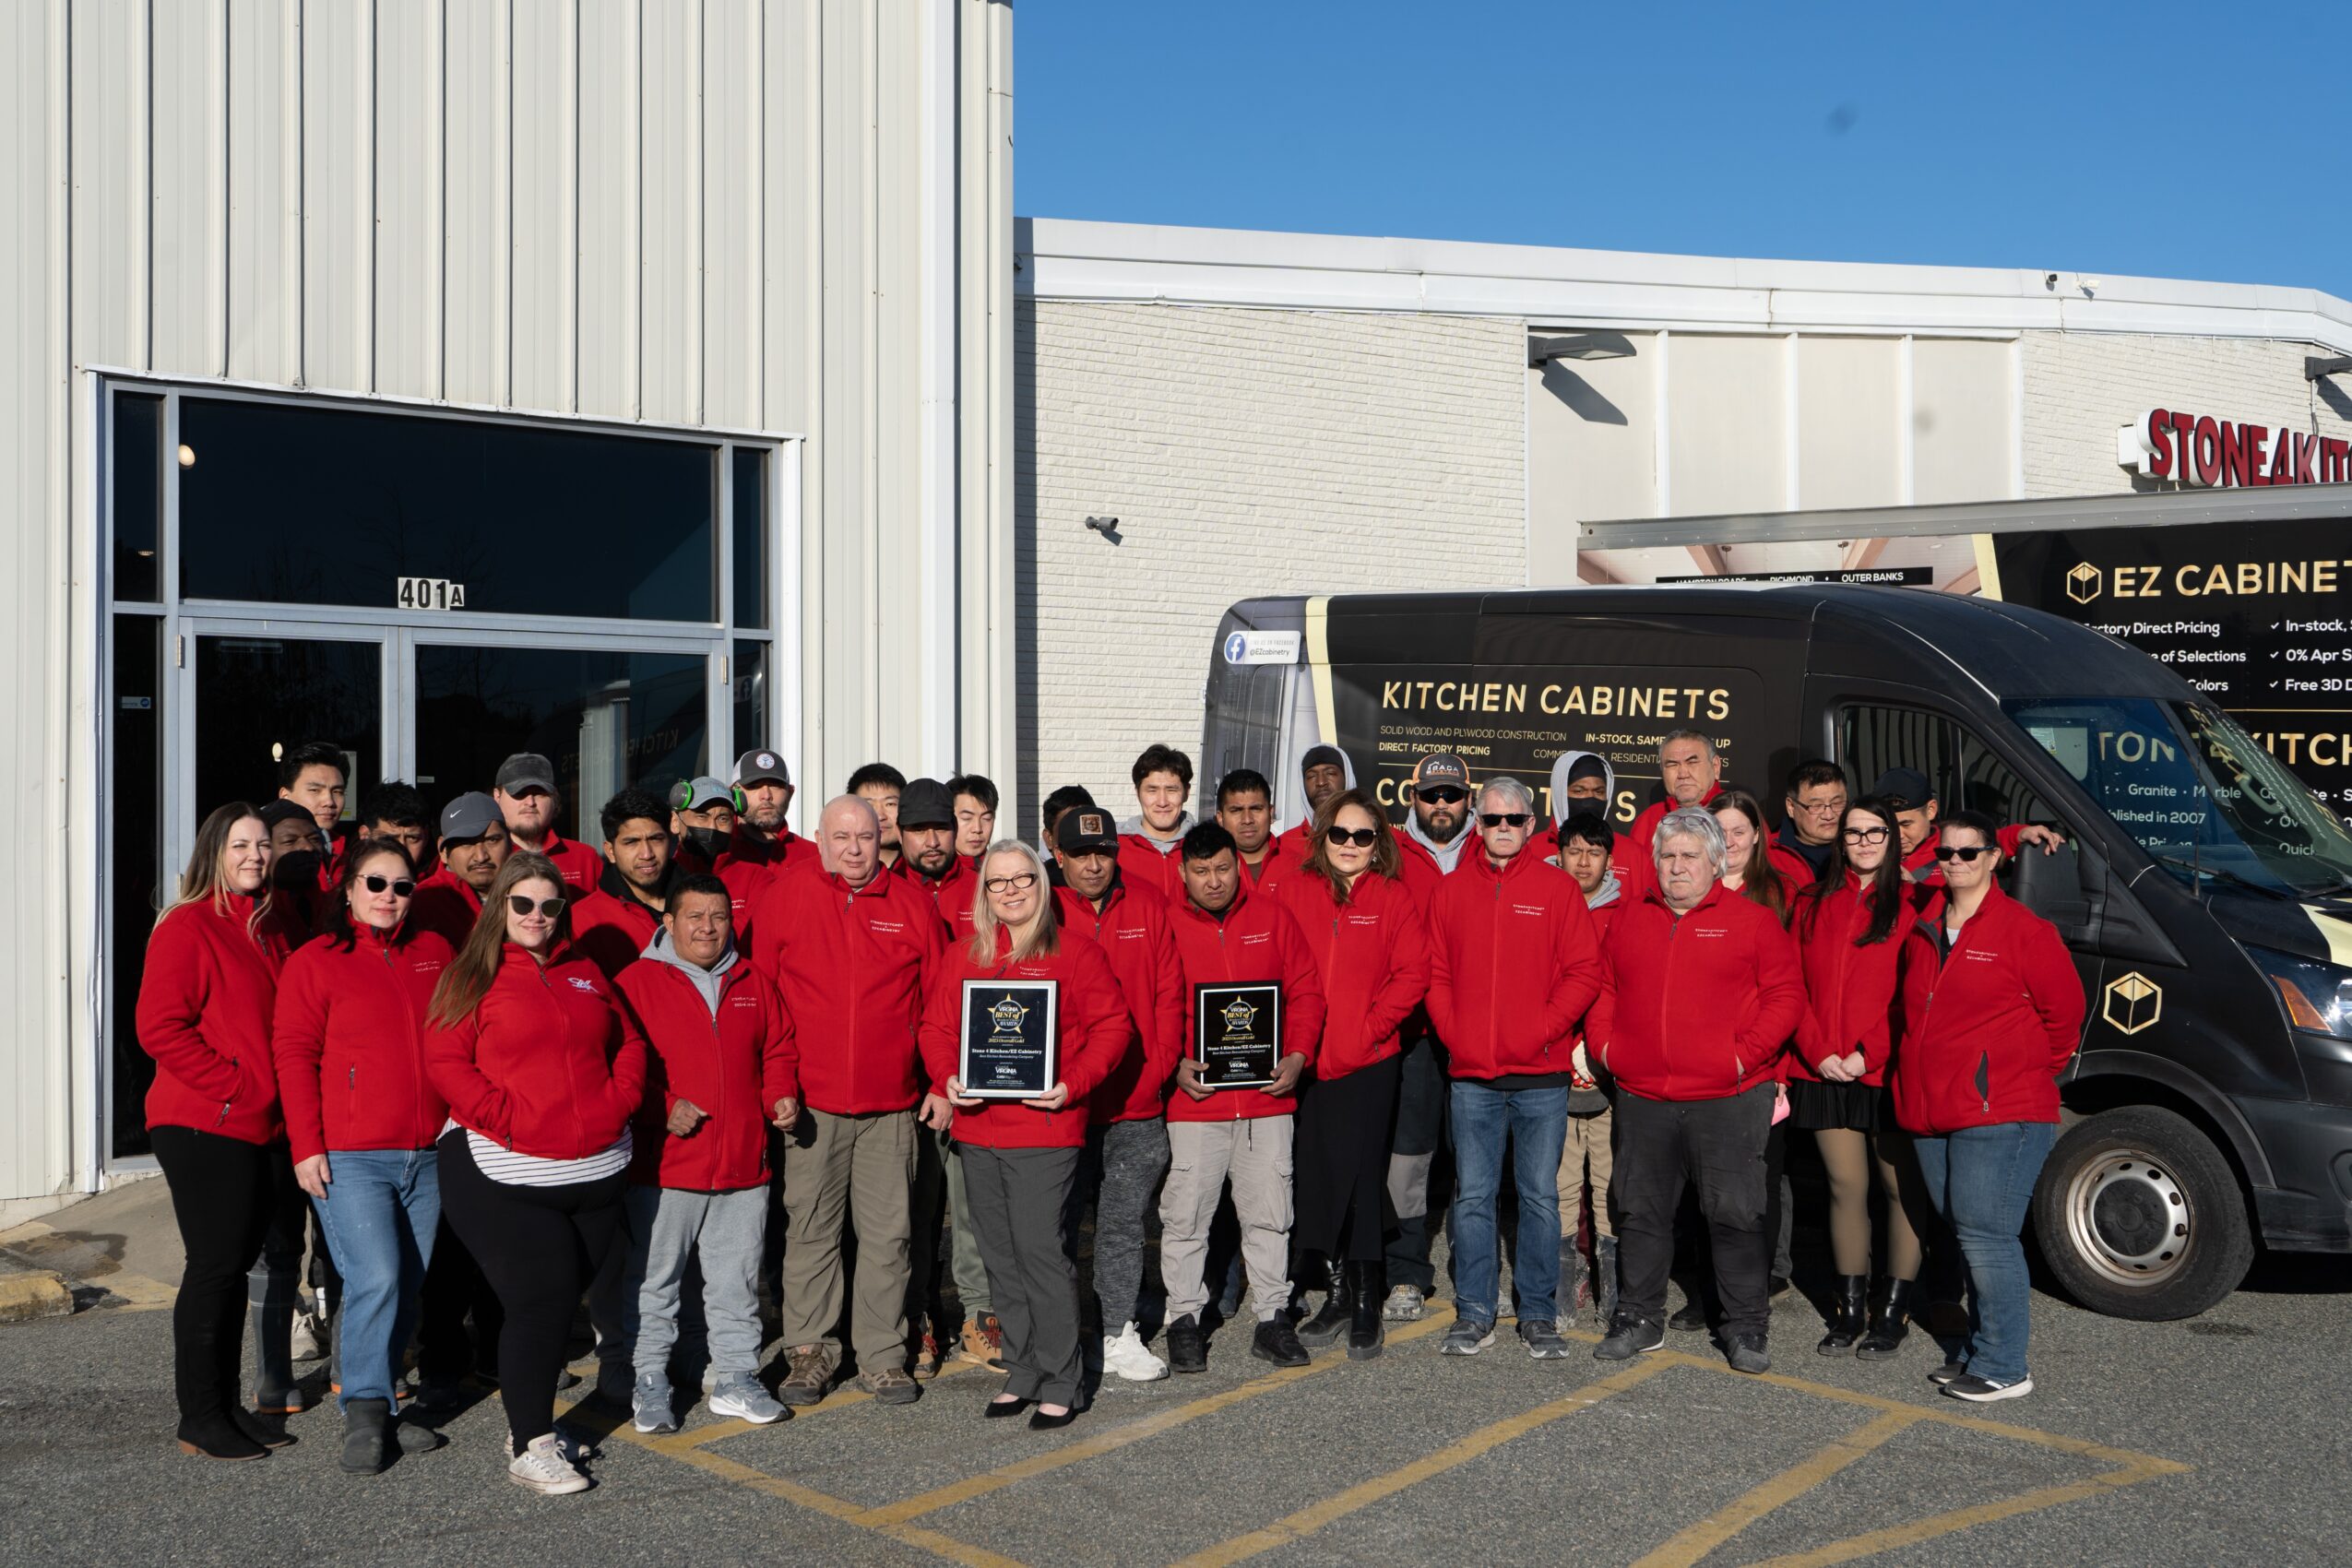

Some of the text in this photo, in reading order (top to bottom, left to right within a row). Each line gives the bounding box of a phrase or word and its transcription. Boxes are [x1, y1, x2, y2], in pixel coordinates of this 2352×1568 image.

[1841, 574, 1872, 583] OUTER
[1872, 572, 1904, 582] BANKS
[2114, 566, 2162, 598] EZ
[399, 579, 463, 609] 401A
[2132, 622, 2173, 635] Direct
[2175, 622, 2221, 637] Pricing
[2286, 619, 2347, 633] In-stock,
[1249, 647, 1290, 657] @EZcabinetry
[2160, 650, 2175, 662] of
[2177, 650, 2247, 662] Selections
[2286, 648, 2309, 661] 0%
[2310, 648, 2340, 664] Apr
[2285, 679, 2319, 691] Free
[2321, 679, 2343, 691] 3D
[1383, 681, 1730, 720] KITCHEN CABINETS
[1380, 725, 1567, 742] SOLID WOOD AND PLYWOOD CONSTRUCTION
[1585, 733, 1635, 745] IN-STOCK,
[1716, 739, 1731, 748] UP
[1379, 742, 1491, 756] DIRECT FACTORY PRICING
[2252, 732, 2352, 766] ITC
[1610, 753, 1661, 765] RESIDENTI
[2128, 784, 2177, 797] Granite
[2193, 785, 2241, 799] Mrble
[2156, 812, 2168, 823] in
[2169, 812, 2206, 824] 2007
[2279, 815, 2299, 827] Ov
